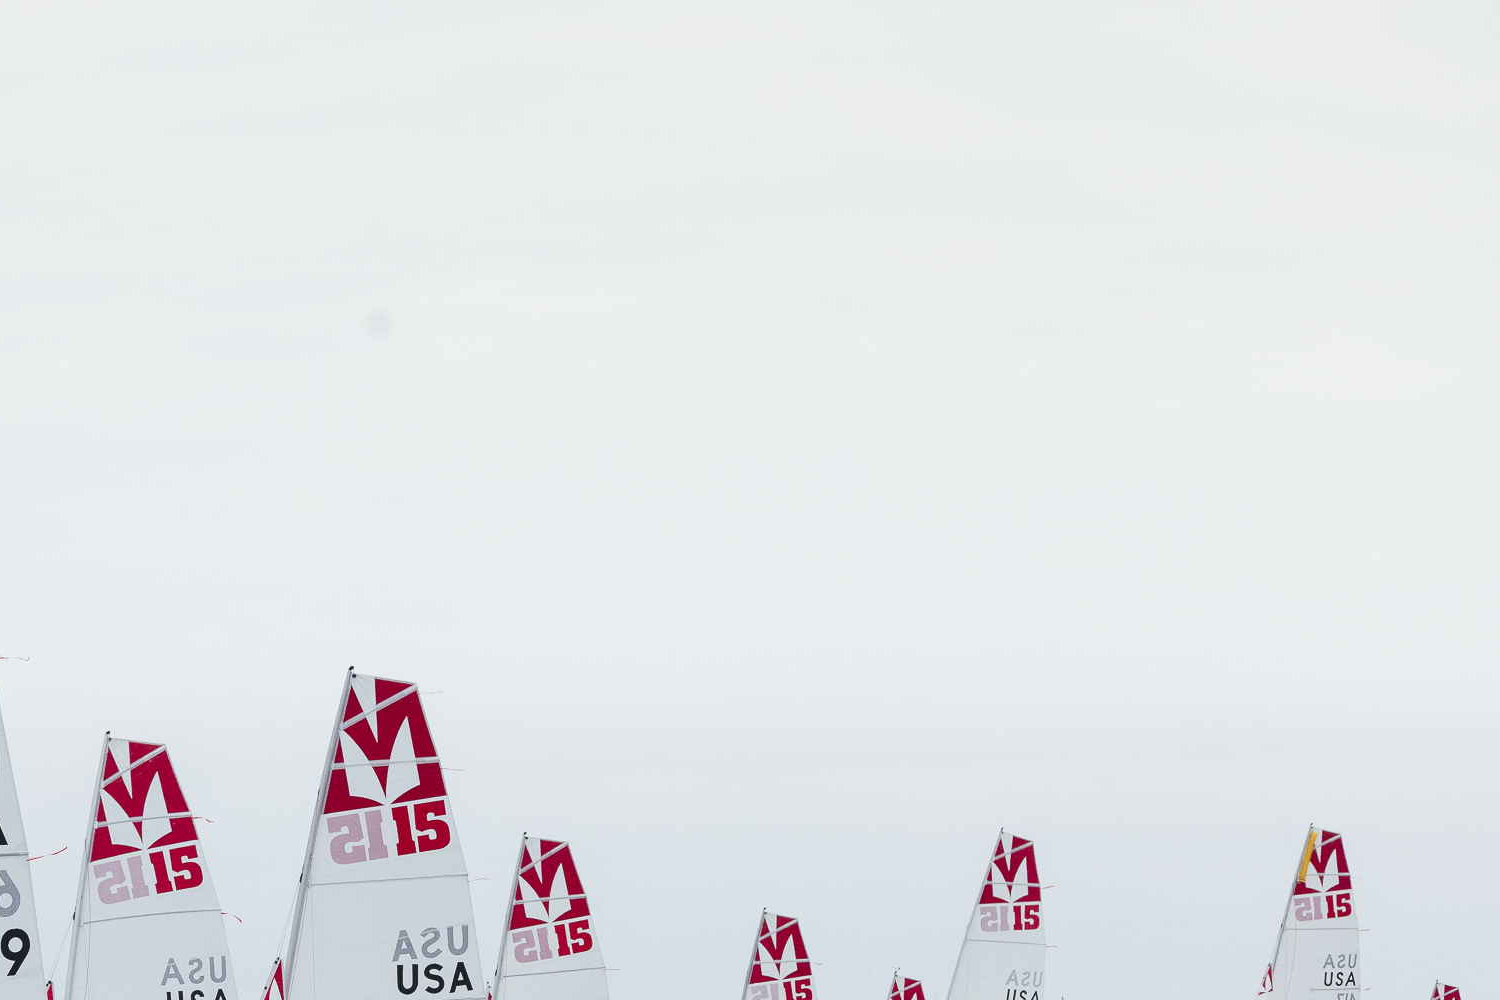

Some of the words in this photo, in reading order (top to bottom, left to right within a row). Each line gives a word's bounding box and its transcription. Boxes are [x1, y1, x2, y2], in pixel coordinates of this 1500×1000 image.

[391, 800, 450, 856] 15
[149, 845, 203, 894] 15
[1013, 904, 1040, 930] 15
[1326, 893, 1352, 919] 15
[555, 919, 593, 957] 15
[397, 962, 473, 995] USA
[1324, 972, 1356, 987] USA
